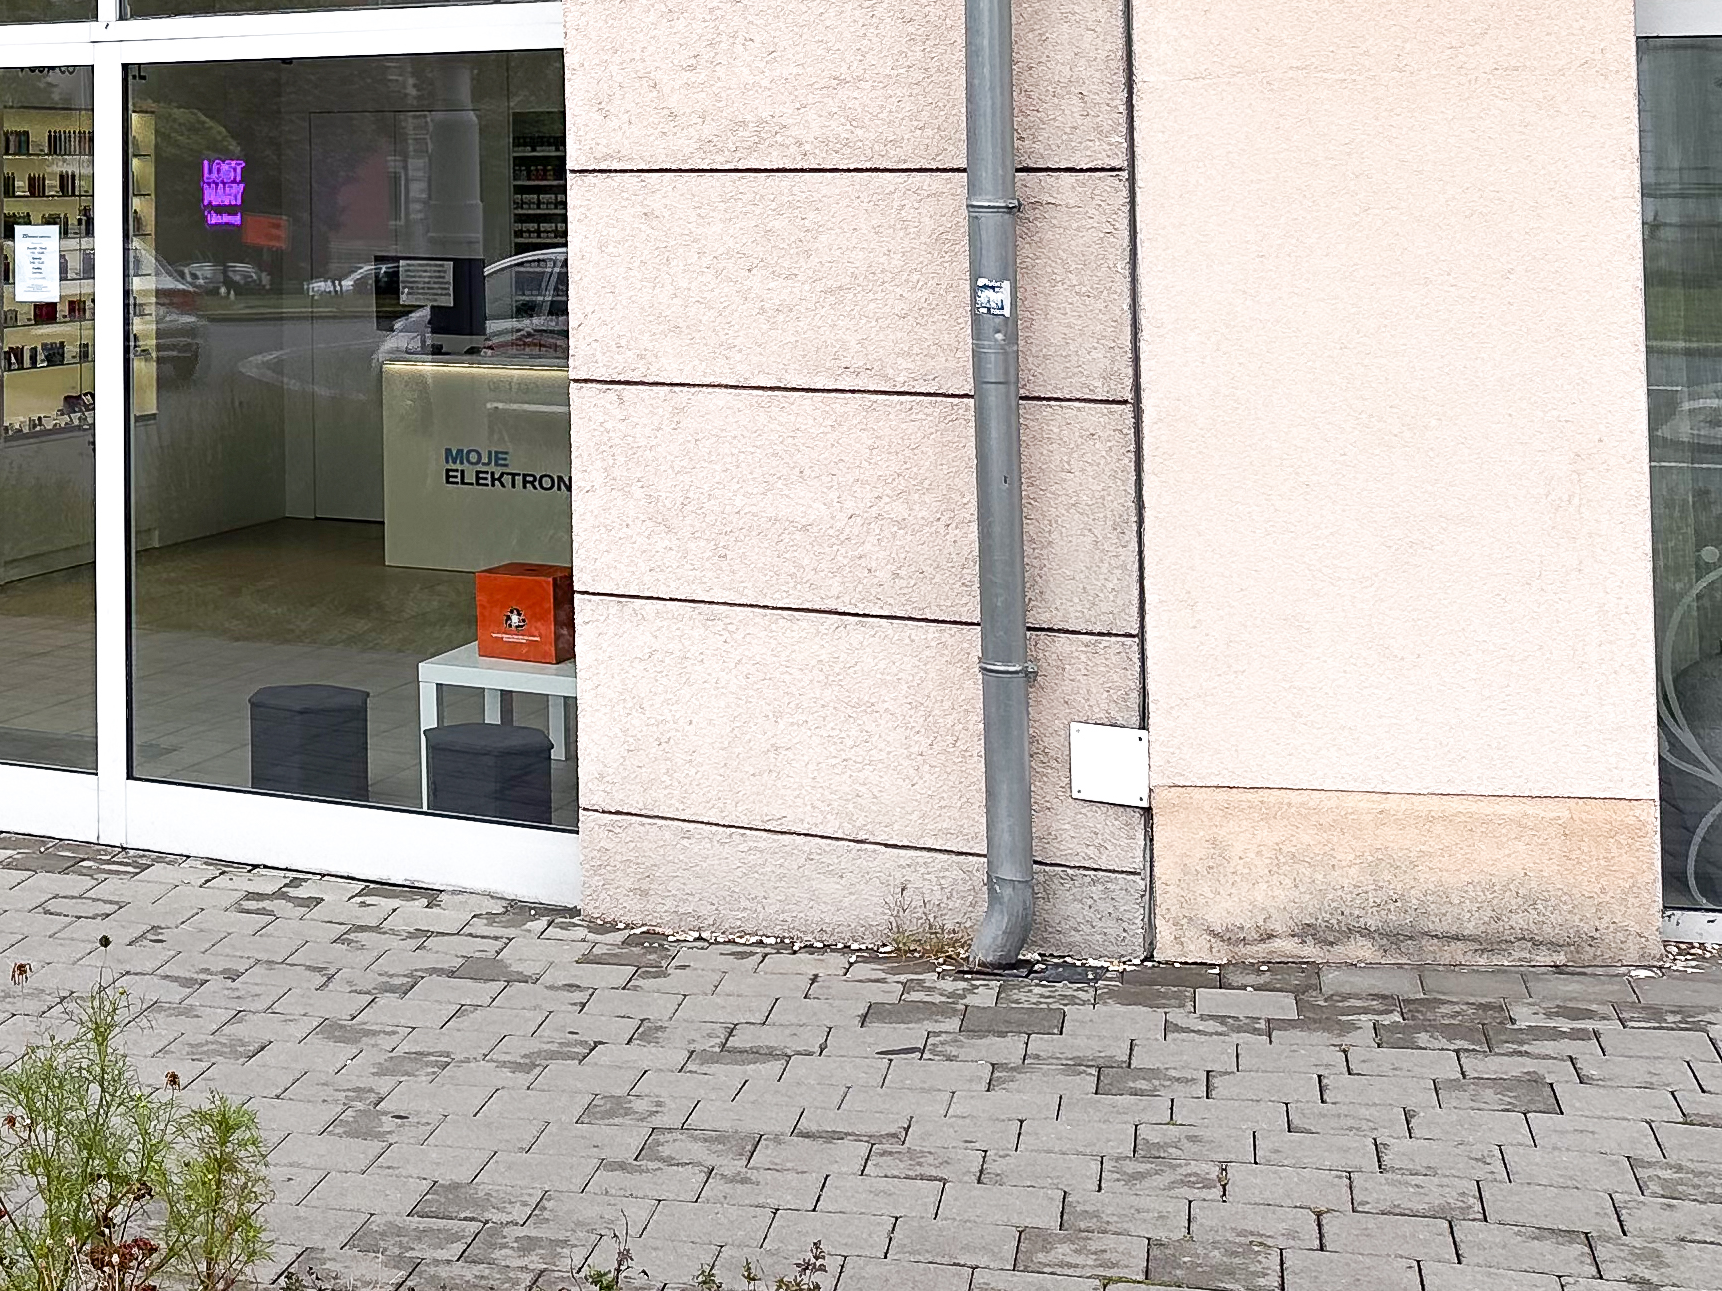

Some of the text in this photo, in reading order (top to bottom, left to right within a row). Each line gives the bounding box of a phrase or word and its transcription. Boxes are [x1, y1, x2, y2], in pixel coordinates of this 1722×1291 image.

[202, 159, 246, 183] LOST
[444, 447, 510, 468] MOJE
[444, 467, 572, 493] ELEKTRON
